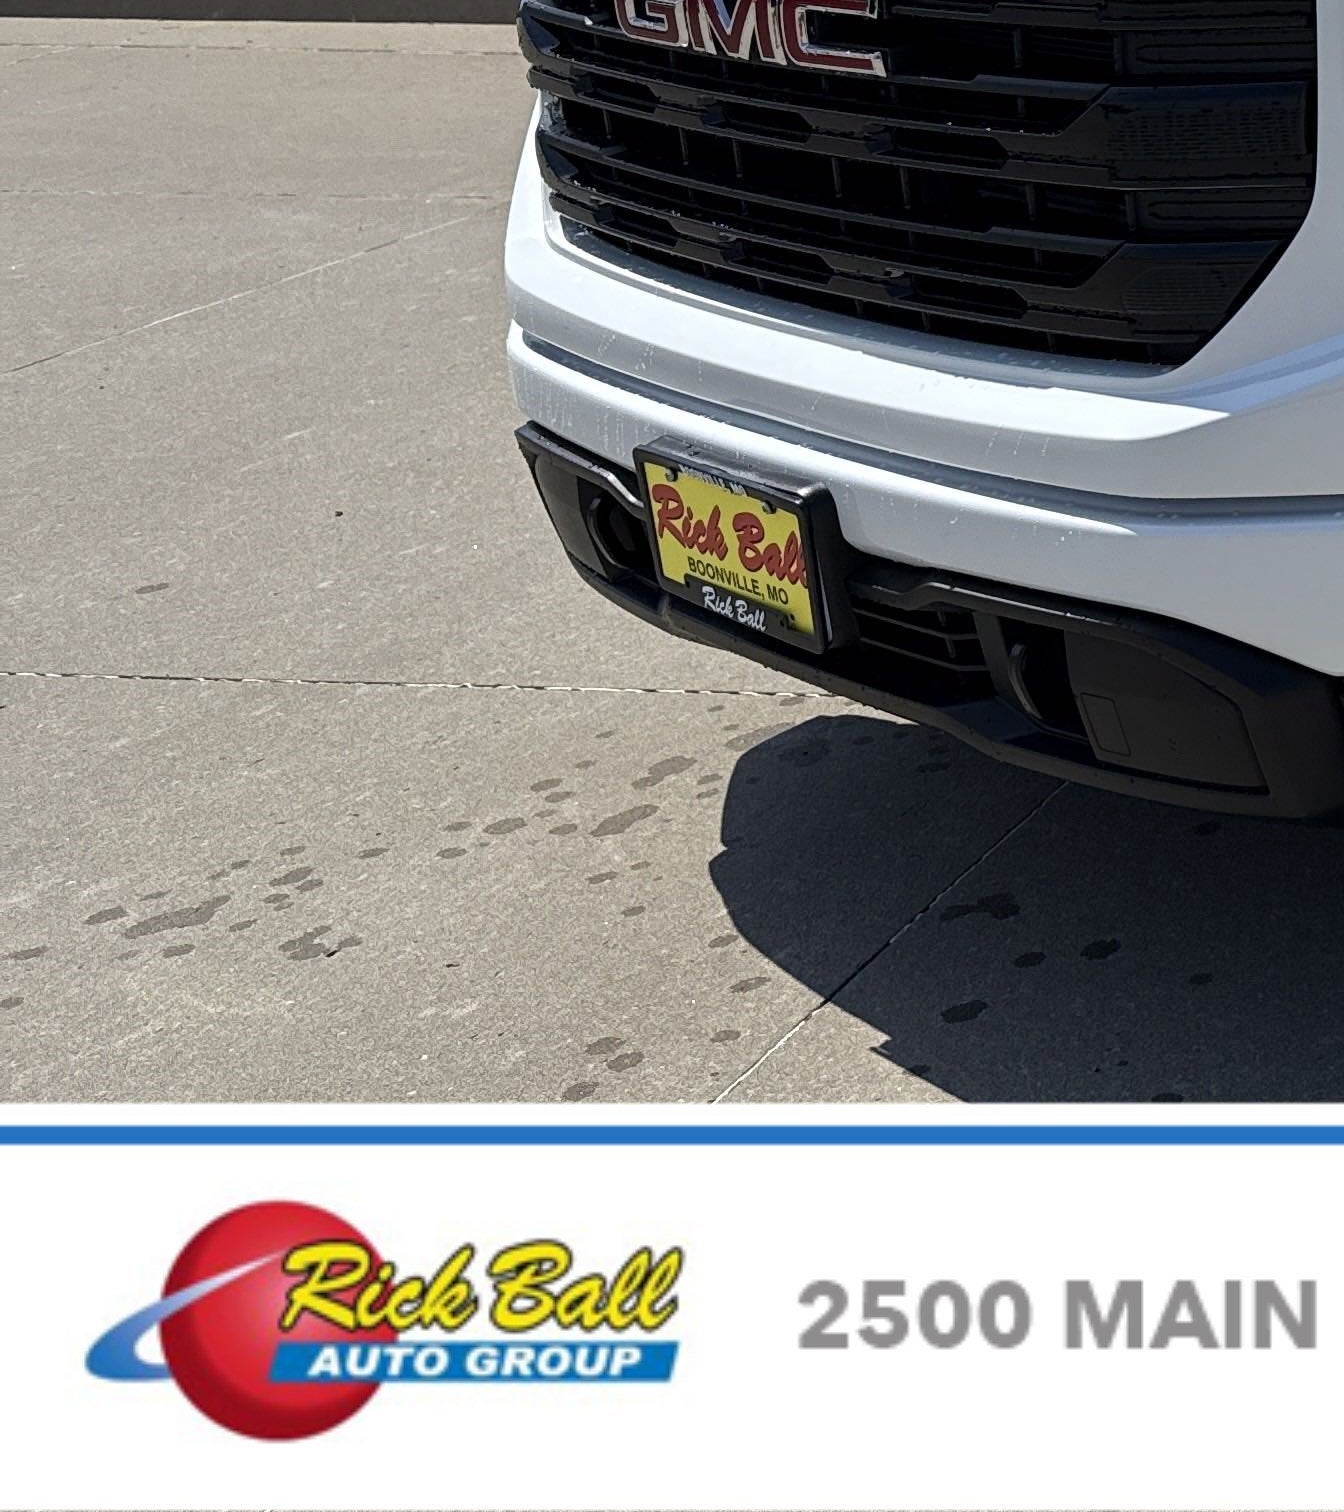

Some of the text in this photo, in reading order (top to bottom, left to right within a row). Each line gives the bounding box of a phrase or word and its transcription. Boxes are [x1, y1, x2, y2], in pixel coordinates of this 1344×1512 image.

[651, 483, 728, 561] Rick
[687, 555, 789, 605] BOONVILLE, MO
[702, 585, 766, 632] Rick Ball
